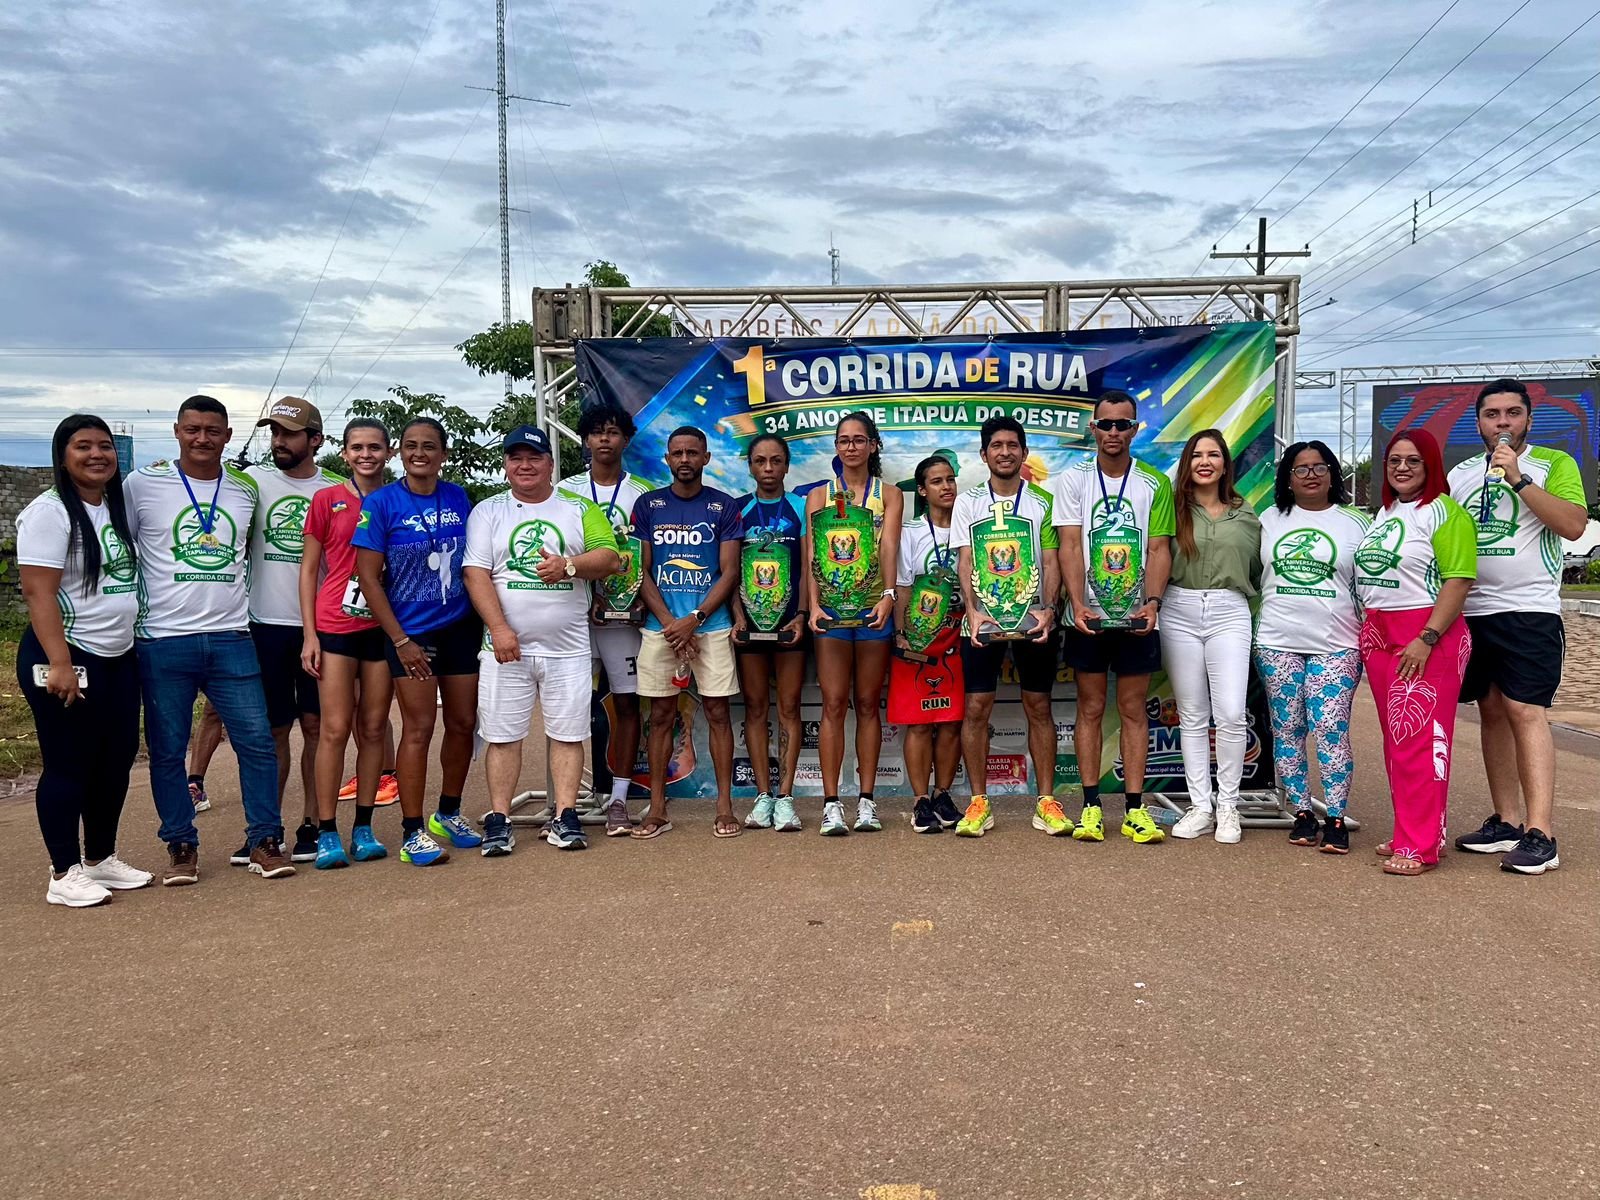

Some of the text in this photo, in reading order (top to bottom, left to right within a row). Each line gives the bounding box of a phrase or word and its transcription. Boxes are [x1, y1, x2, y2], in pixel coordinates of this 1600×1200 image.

[733, 345, 1089, 405] 1ª CORRIDA DE RUA
[765, 414, 789, 434] 34
[894, 401, 969, 424] ITAPUÃ
[975, 407, 996, 423] DO
[1011, 407, 1080, 429] OESTE
[988, 500, 1015, 531] 1º
[1106, 511, 1134, 537] 2º
[653, 530, 703, 546] sono
[656, 564, 712, 587] JACIARA
[1283, 587, 1311, 595] CORRIDA
[921, 697, 951, 711] RUN
